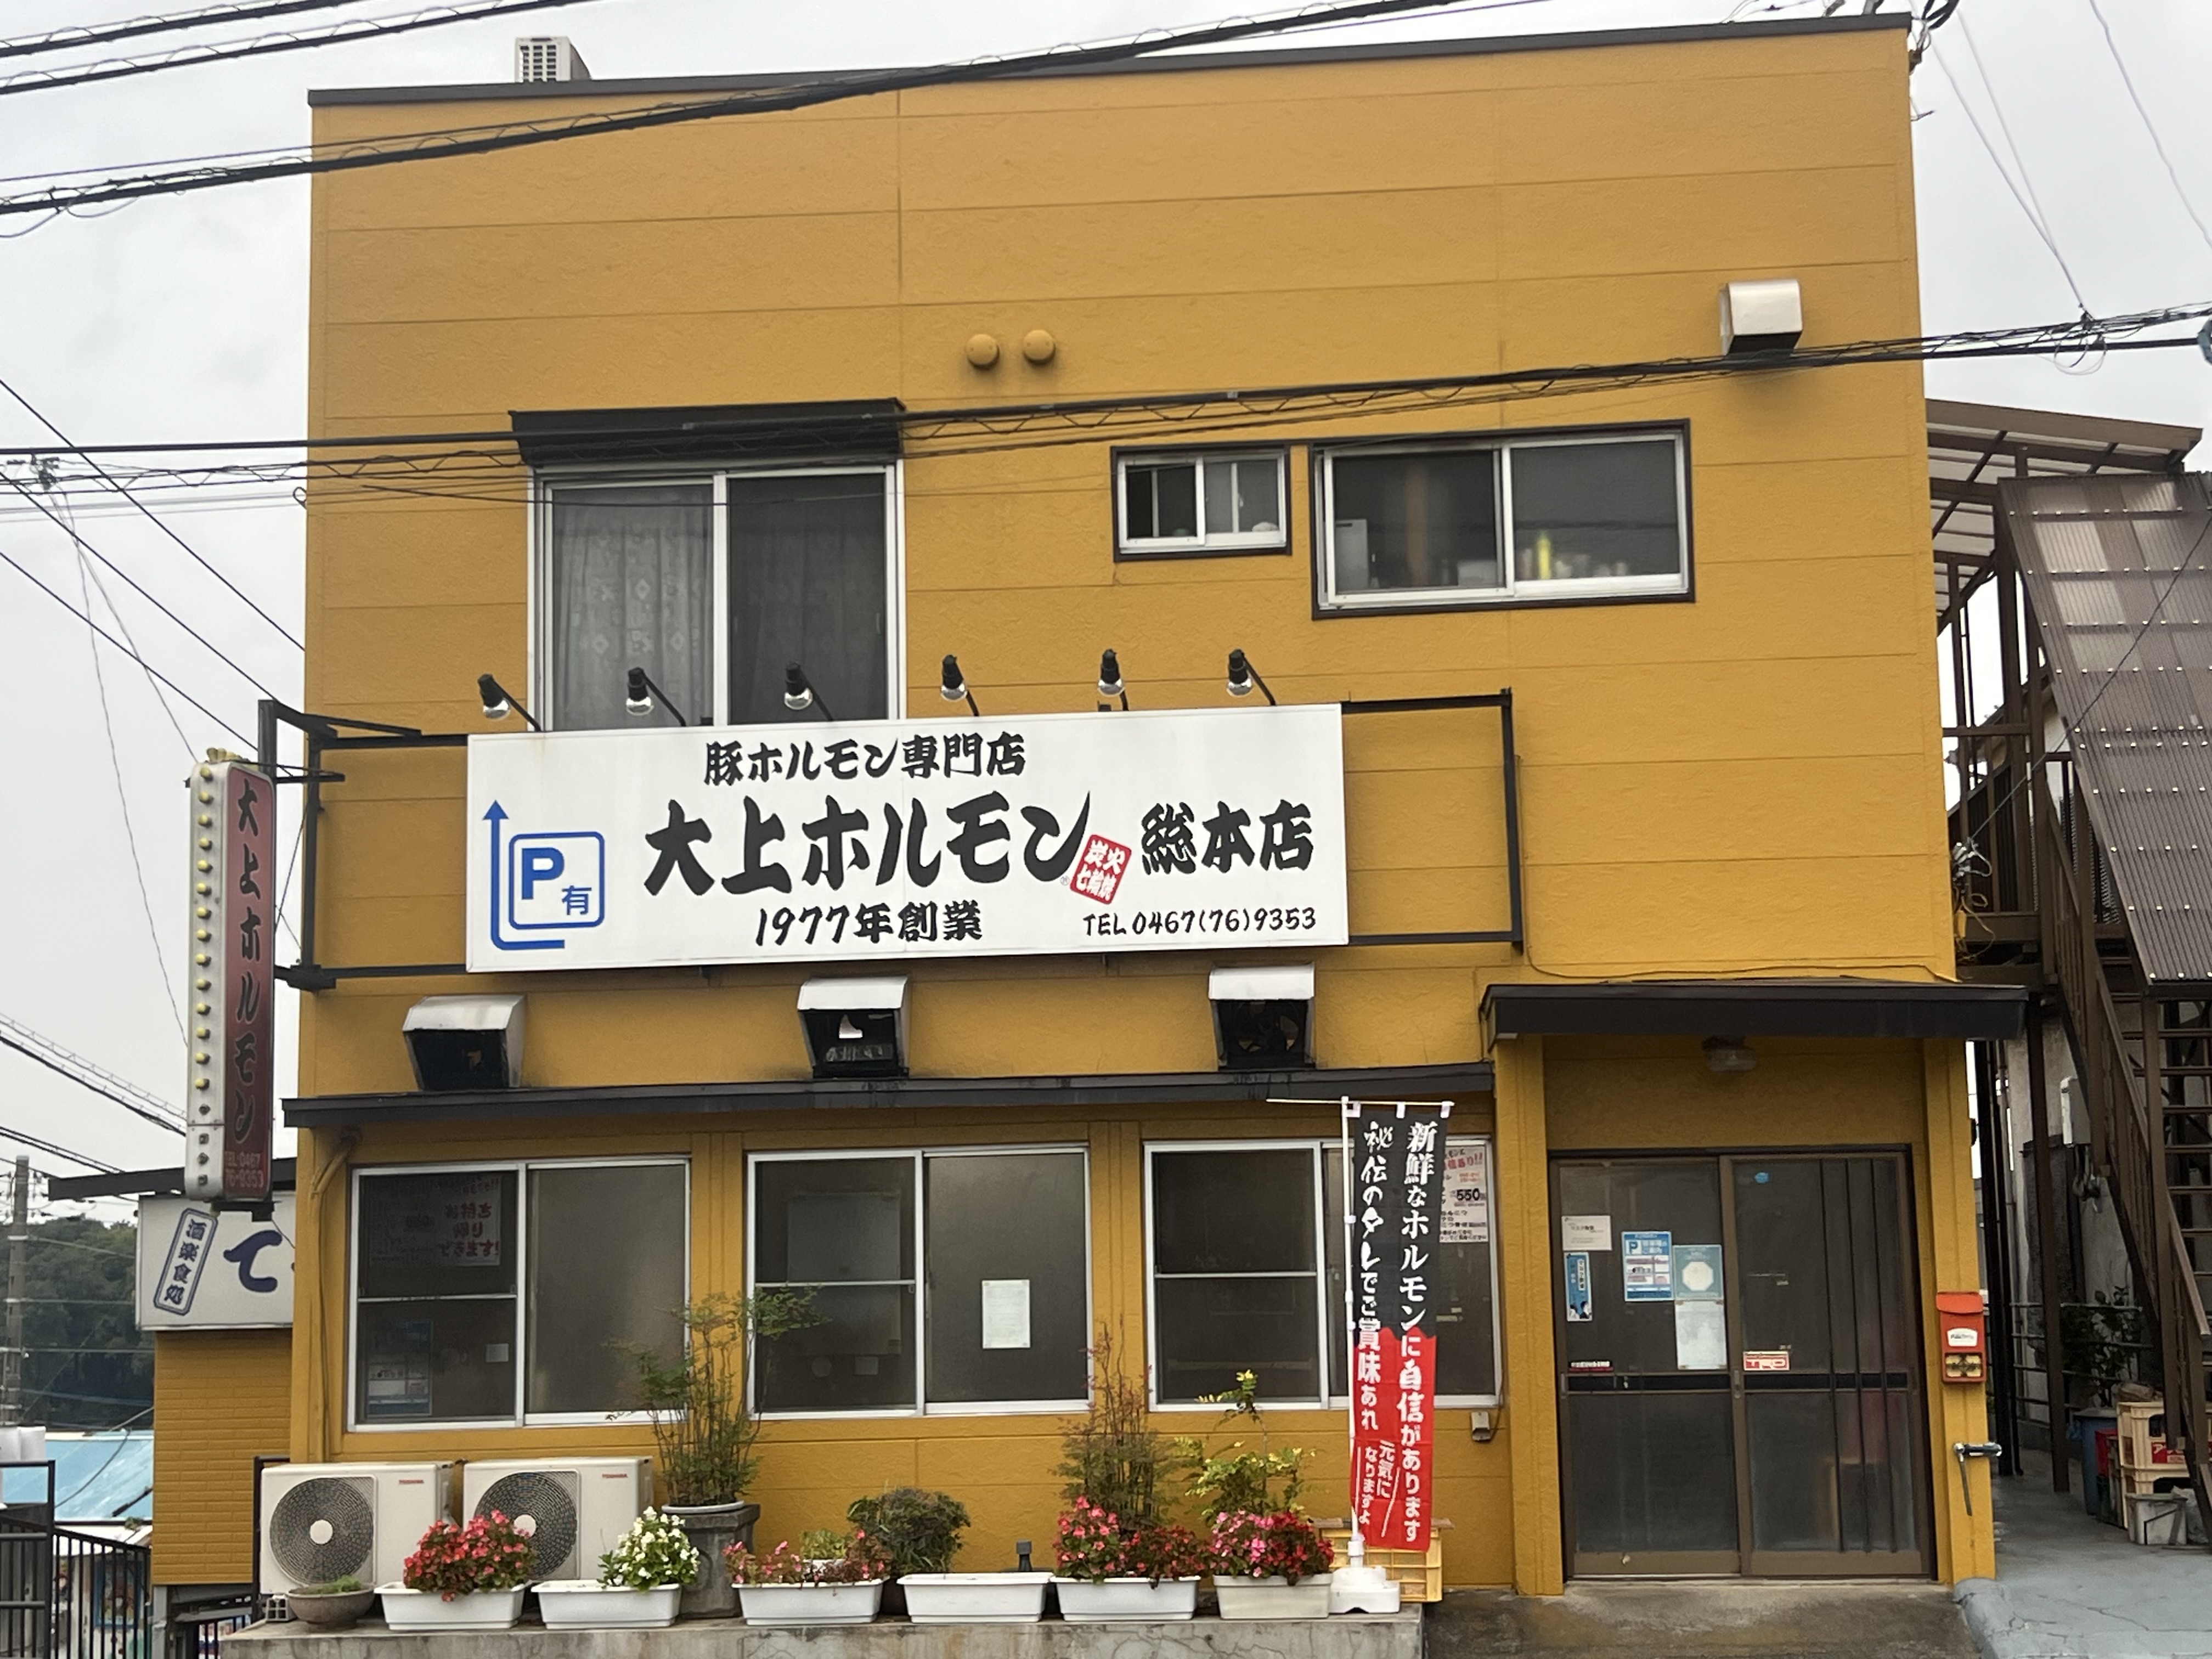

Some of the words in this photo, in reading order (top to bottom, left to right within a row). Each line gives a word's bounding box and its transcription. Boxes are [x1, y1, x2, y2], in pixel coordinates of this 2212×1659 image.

[704, 732, 1026, 786] 豚ホルモン専門店
[522, 847, 565, 900] P
[644, 791, 1091, 896] 大上ホルモン
[1142, 800, 1314, 875] 総本店
[562, 885, 592, 916] 有
[755, 900, 983, 946] 1977年創業
[1084, 914, 1126, 936] TEL
[1132, 907, 1316, 935] 0467(76)9353
[234, 779, 261, 1143] 大上ホルモン
[164, 1219, 207, 1305] 酒楽食処
[223, 1229, 283, 1293] て
[1358, 1121, 1394, 1430] 秘伝のタレでご賞味あれ
[1396, 1121, 1438, 1543] 新鮮なホルモンに自信があります
[1358, 1446, 1378, 1525] なりますよ
[1376, 1440, 1396, 1498] 元気に
